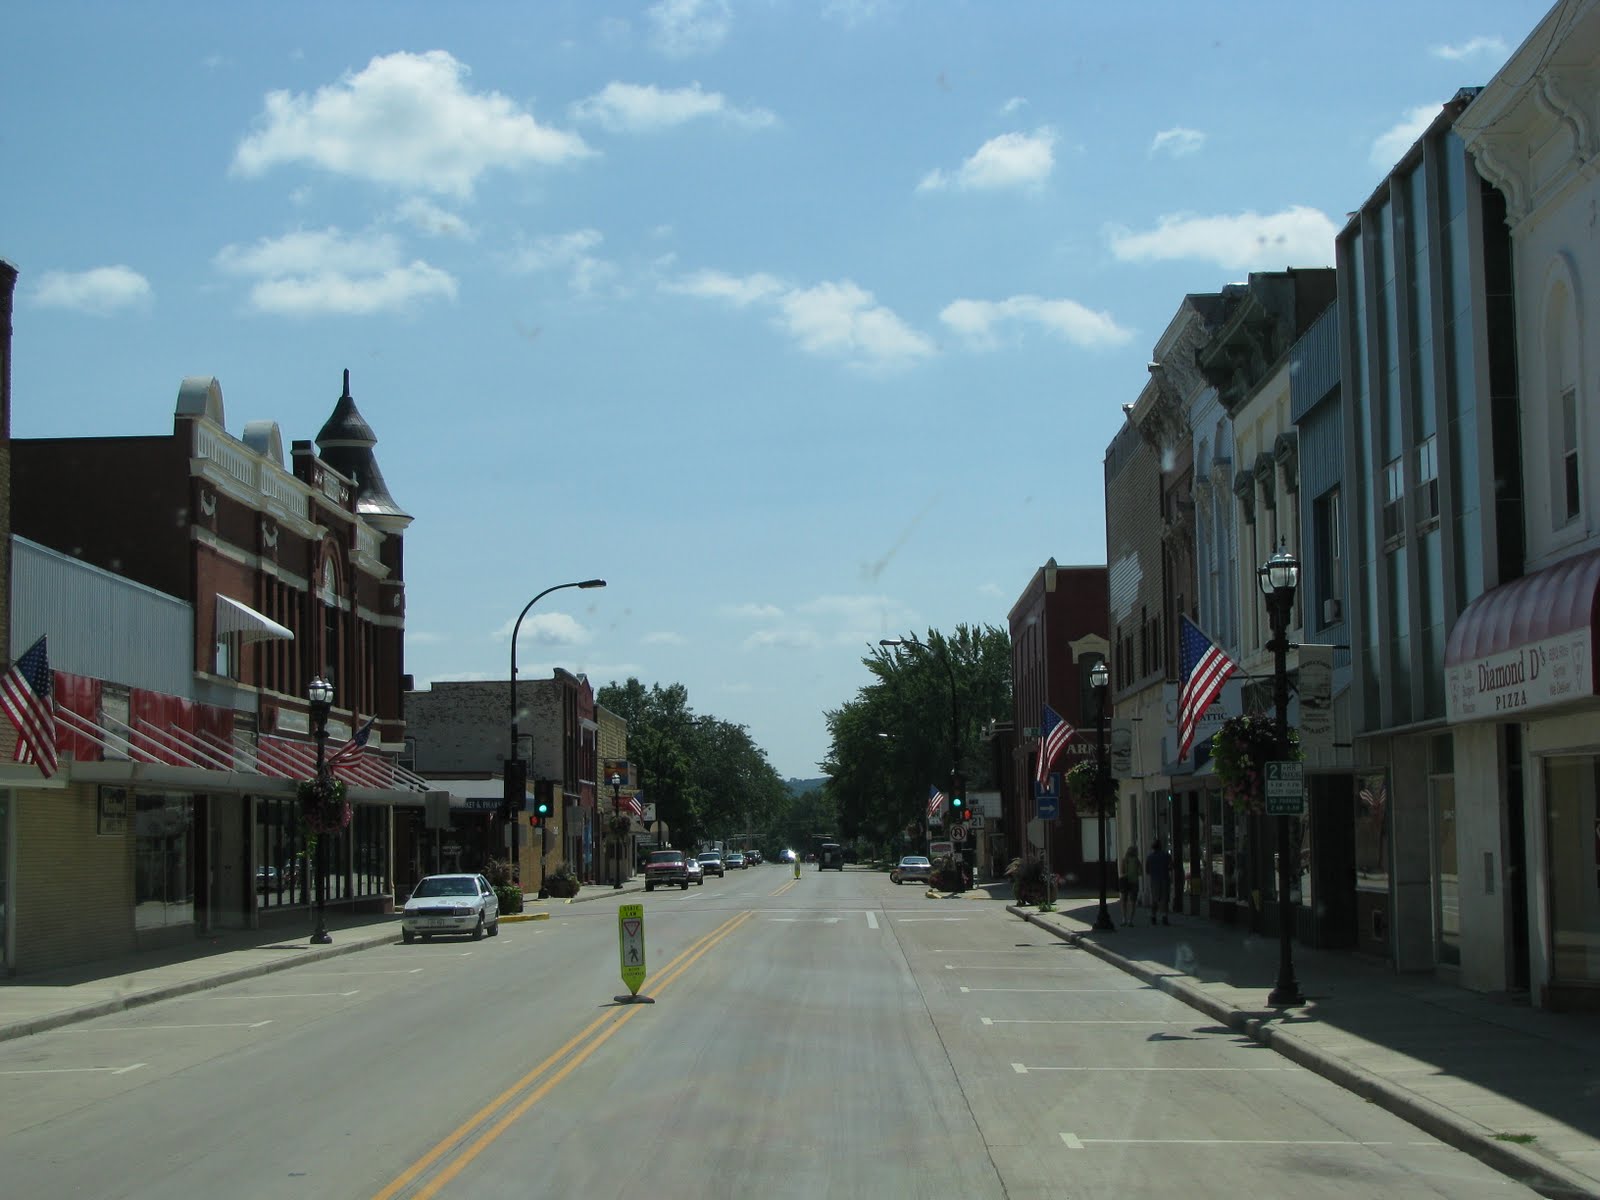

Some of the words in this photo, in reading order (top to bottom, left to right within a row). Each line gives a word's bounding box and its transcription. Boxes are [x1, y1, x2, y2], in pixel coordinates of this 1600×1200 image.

[1478, 650, 1525, 693] Diamond
[1529, 646, 1546, 681] D's
[1496, 690, 1527, 711] PIZZA
[1269, 764, 1278, 779] 2
[972, 817, 982, 827] 21
